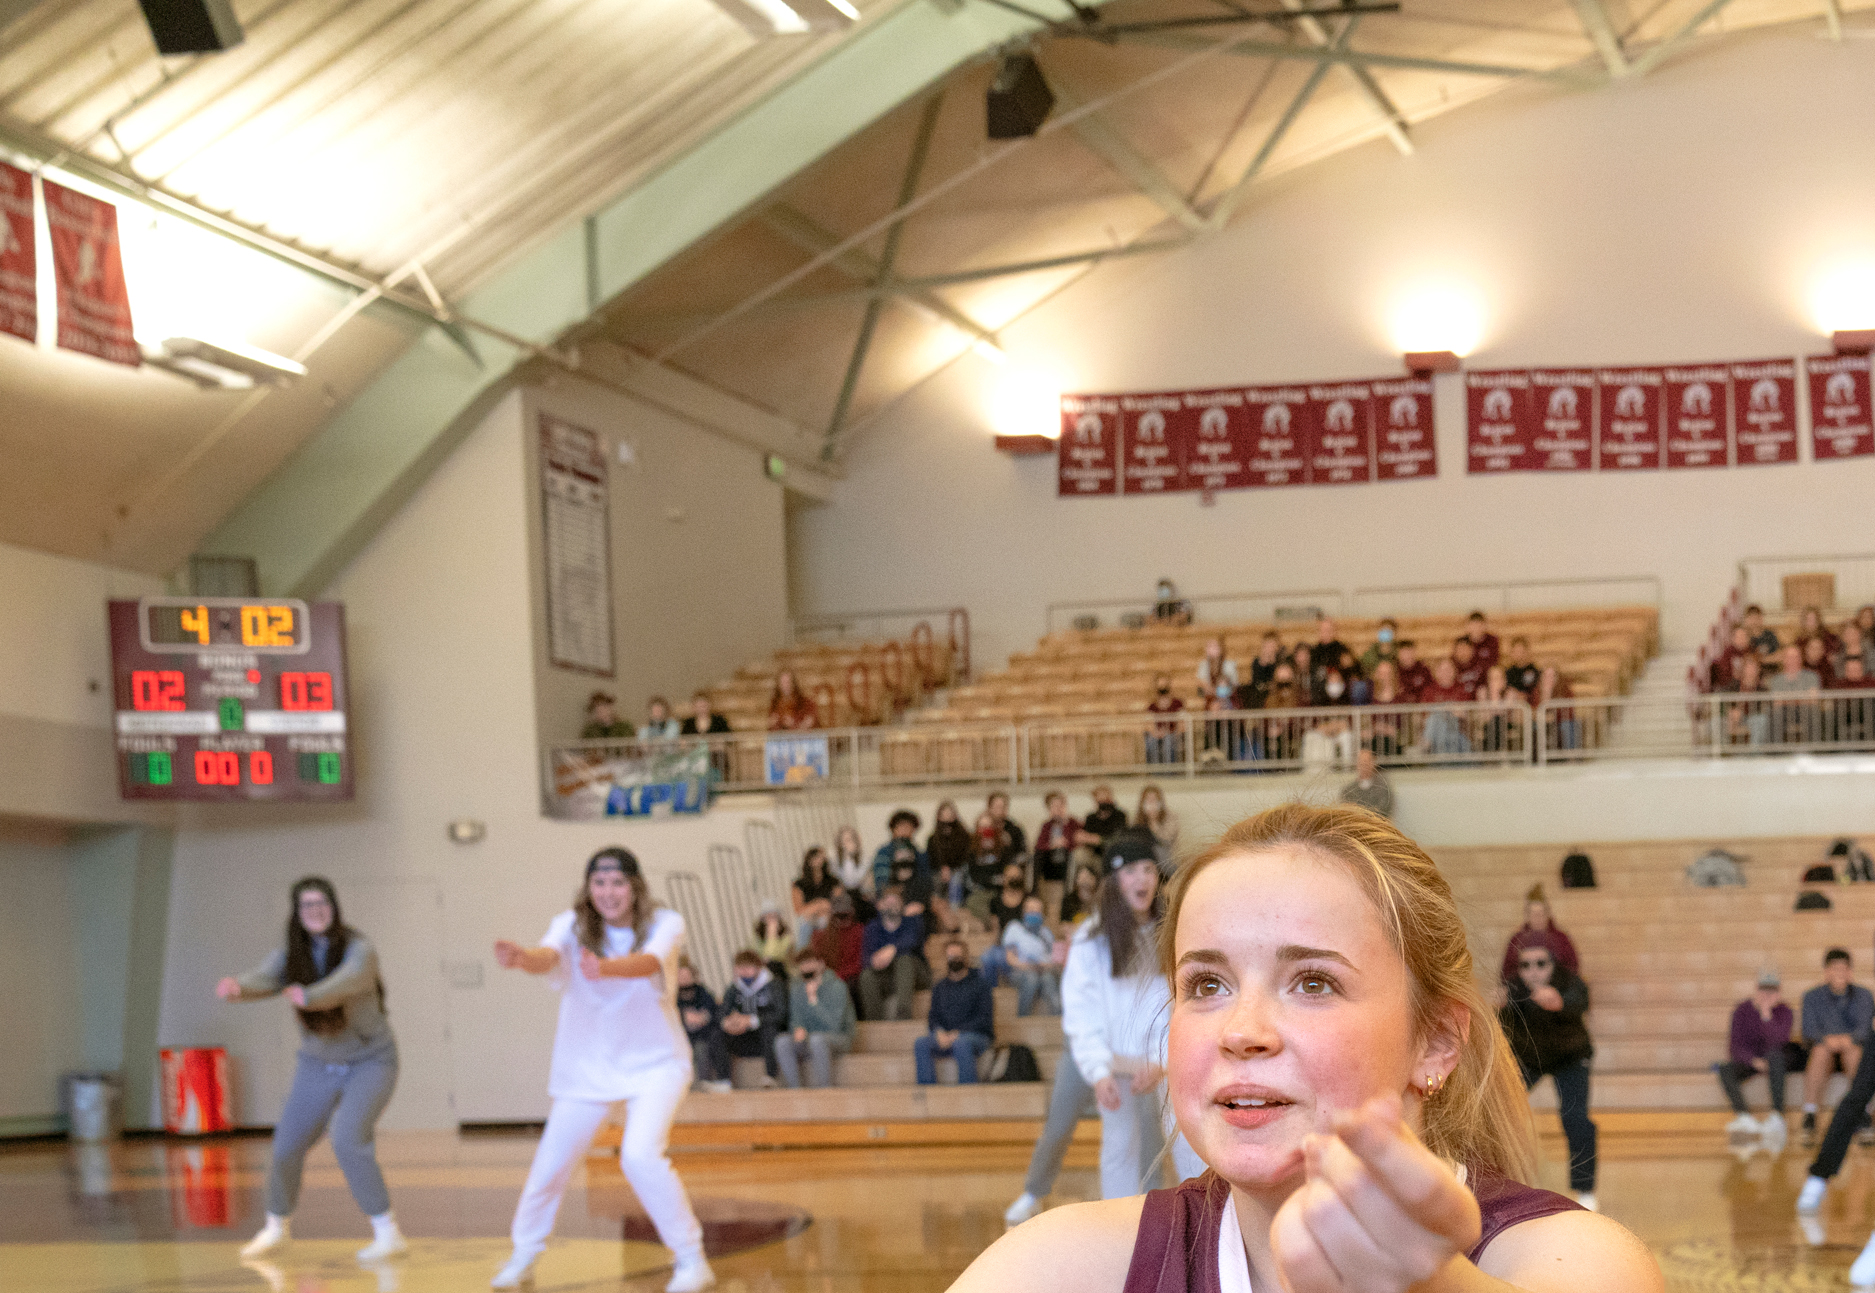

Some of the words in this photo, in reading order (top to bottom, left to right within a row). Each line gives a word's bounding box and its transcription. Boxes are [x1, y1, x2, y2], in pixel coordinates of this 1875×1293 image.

[180, 604, 210, 646] 4
[240, 605, 294, 647] 02
[132, 669, 186, 712] 02
[280, 671, 333, 712] 03
[149, 751, 173, 785] 0
[194, 750, 241, 786] 00
[249, 750, 274, 786] 0
[317, 751, 341, 785] 0
